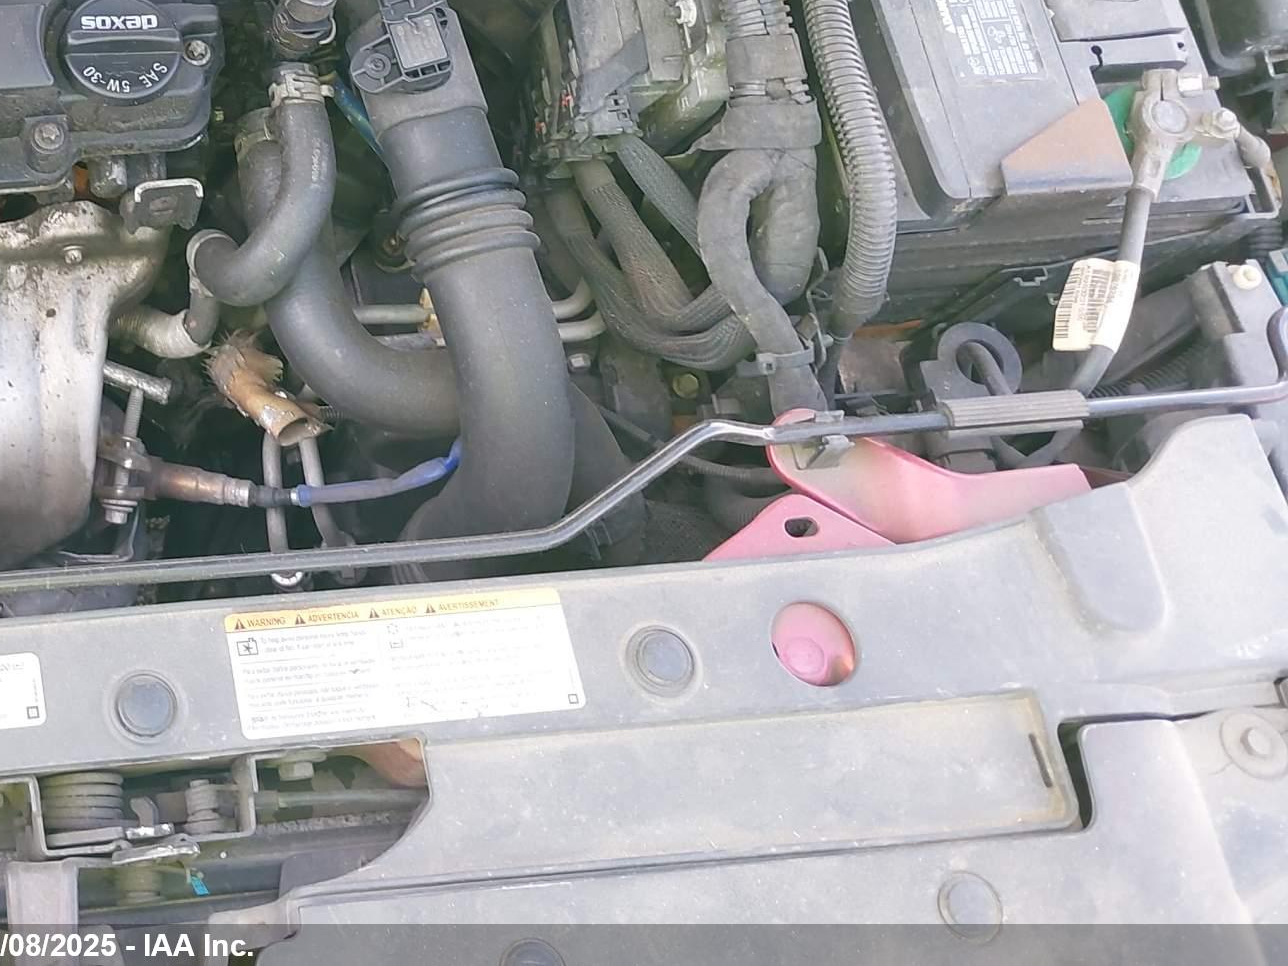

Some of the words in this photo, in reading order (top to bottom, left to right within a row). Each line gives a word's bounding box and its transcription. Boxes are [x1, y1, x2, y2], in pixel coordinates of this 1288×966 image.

[81, 14, 158, 30] dexos
[82, 66, 130, 93] 5W-30
[138, 62, 168, 88] SAE
[438, 598, 499, 613] AVERTISSEMENT
[246, 615, 286, 628] WARNING
[308, 610, 360, 624] ADVERTENCIA
